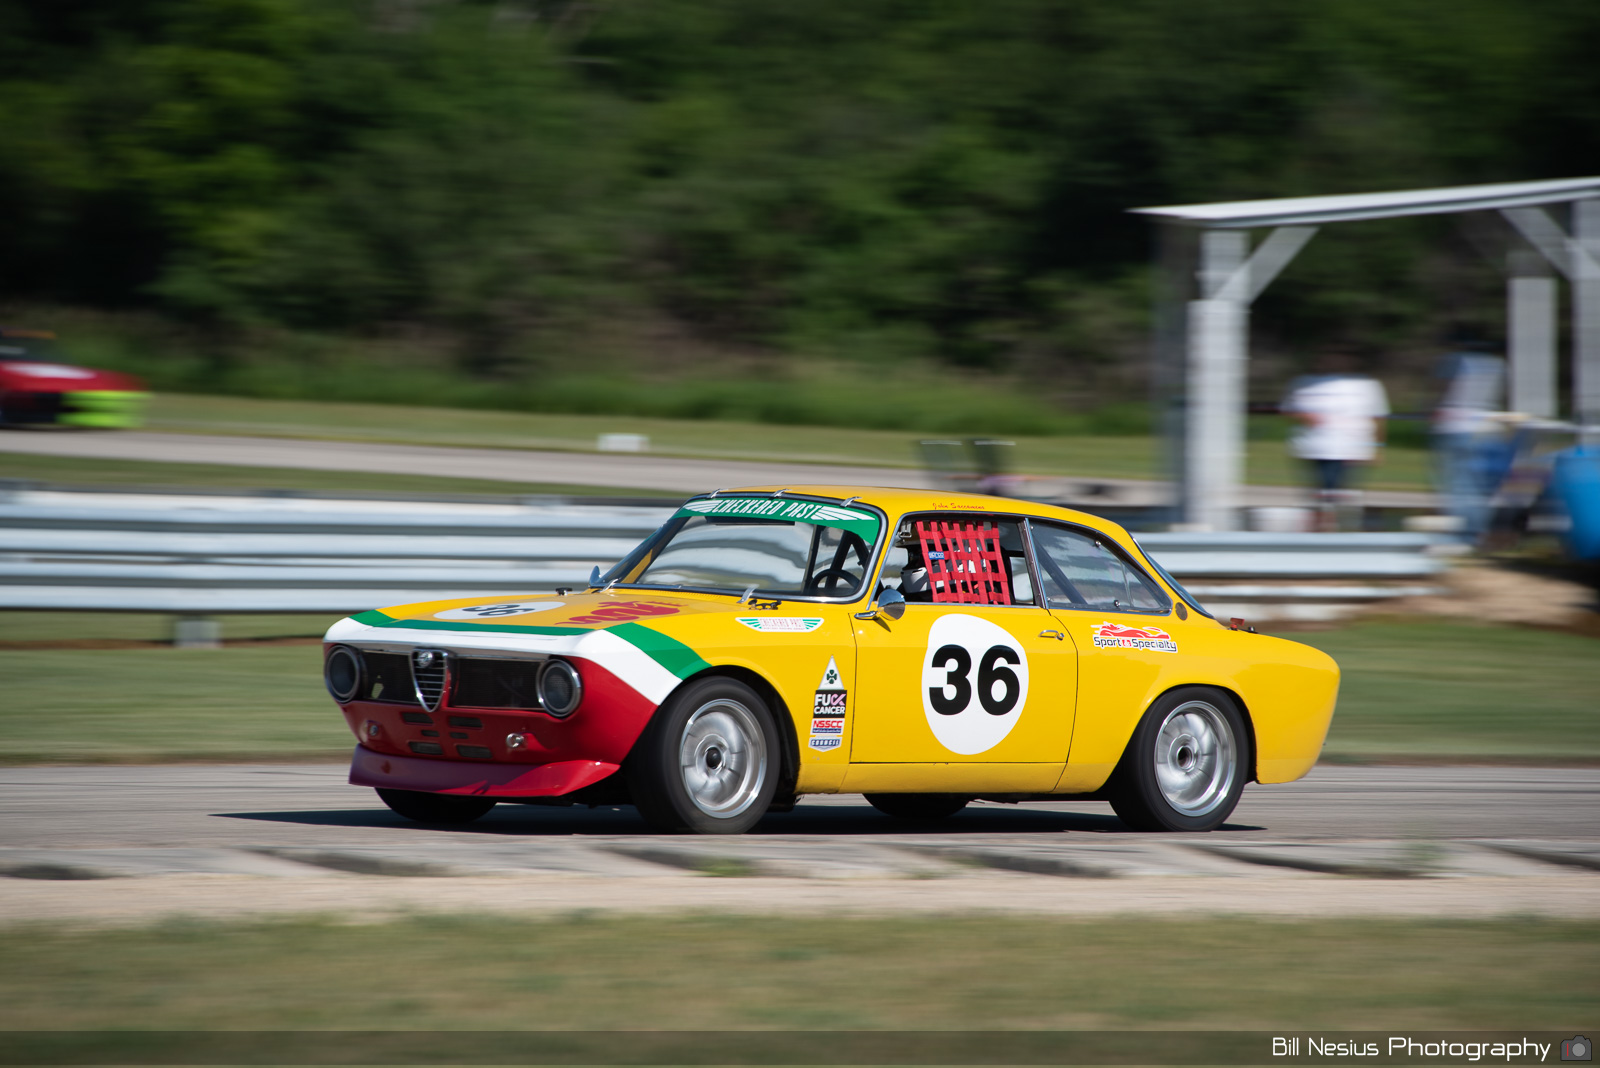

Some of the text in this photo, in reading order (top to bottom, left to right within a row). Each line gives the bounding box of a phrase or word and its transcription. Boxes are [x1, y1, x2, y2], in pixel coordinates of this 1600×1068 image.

[711, 499, 823, 519] CHECKERED PAST
[1093, 636, 1122, 648] Sport
[1131, 638, 1177, 652] Specialty
[928, 643, 1021, 717] 36
[815, 693, 847, 706] FUCK
[814, 706, 846, 715] CANCER
[813, 720, 843, 729] NSSCC
